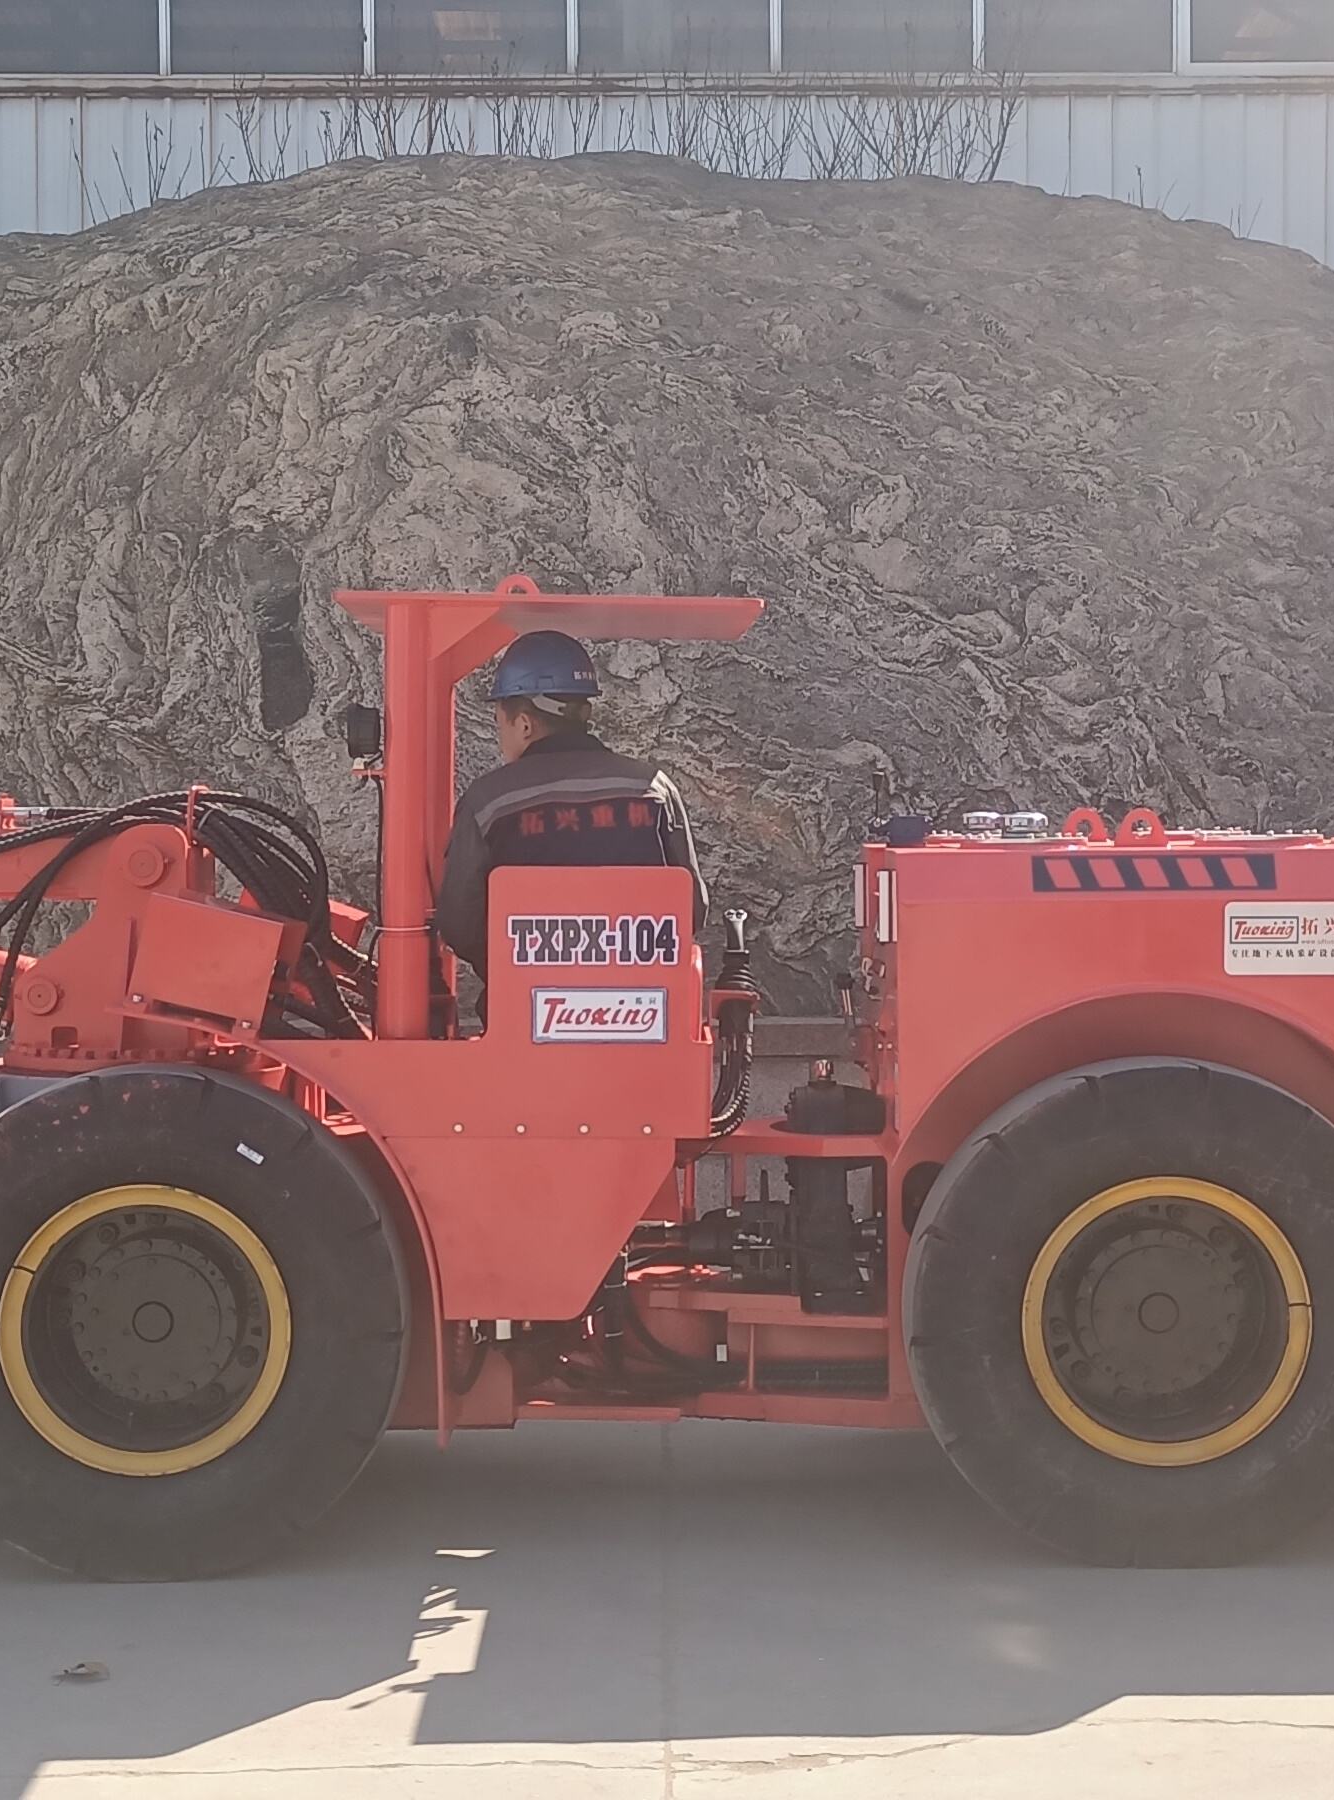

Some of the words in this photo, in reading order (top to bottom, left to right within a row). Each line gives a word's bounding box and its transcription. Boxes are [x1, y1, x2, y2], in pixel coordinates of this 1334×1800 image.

[521, 802, 653, 836] 拓兴重机
[509, 917, 677, 963] TXPX-104
[1234, 920, 1295, 940] Tuoxing
[542, 998, 658, 1034] Tuoxing
